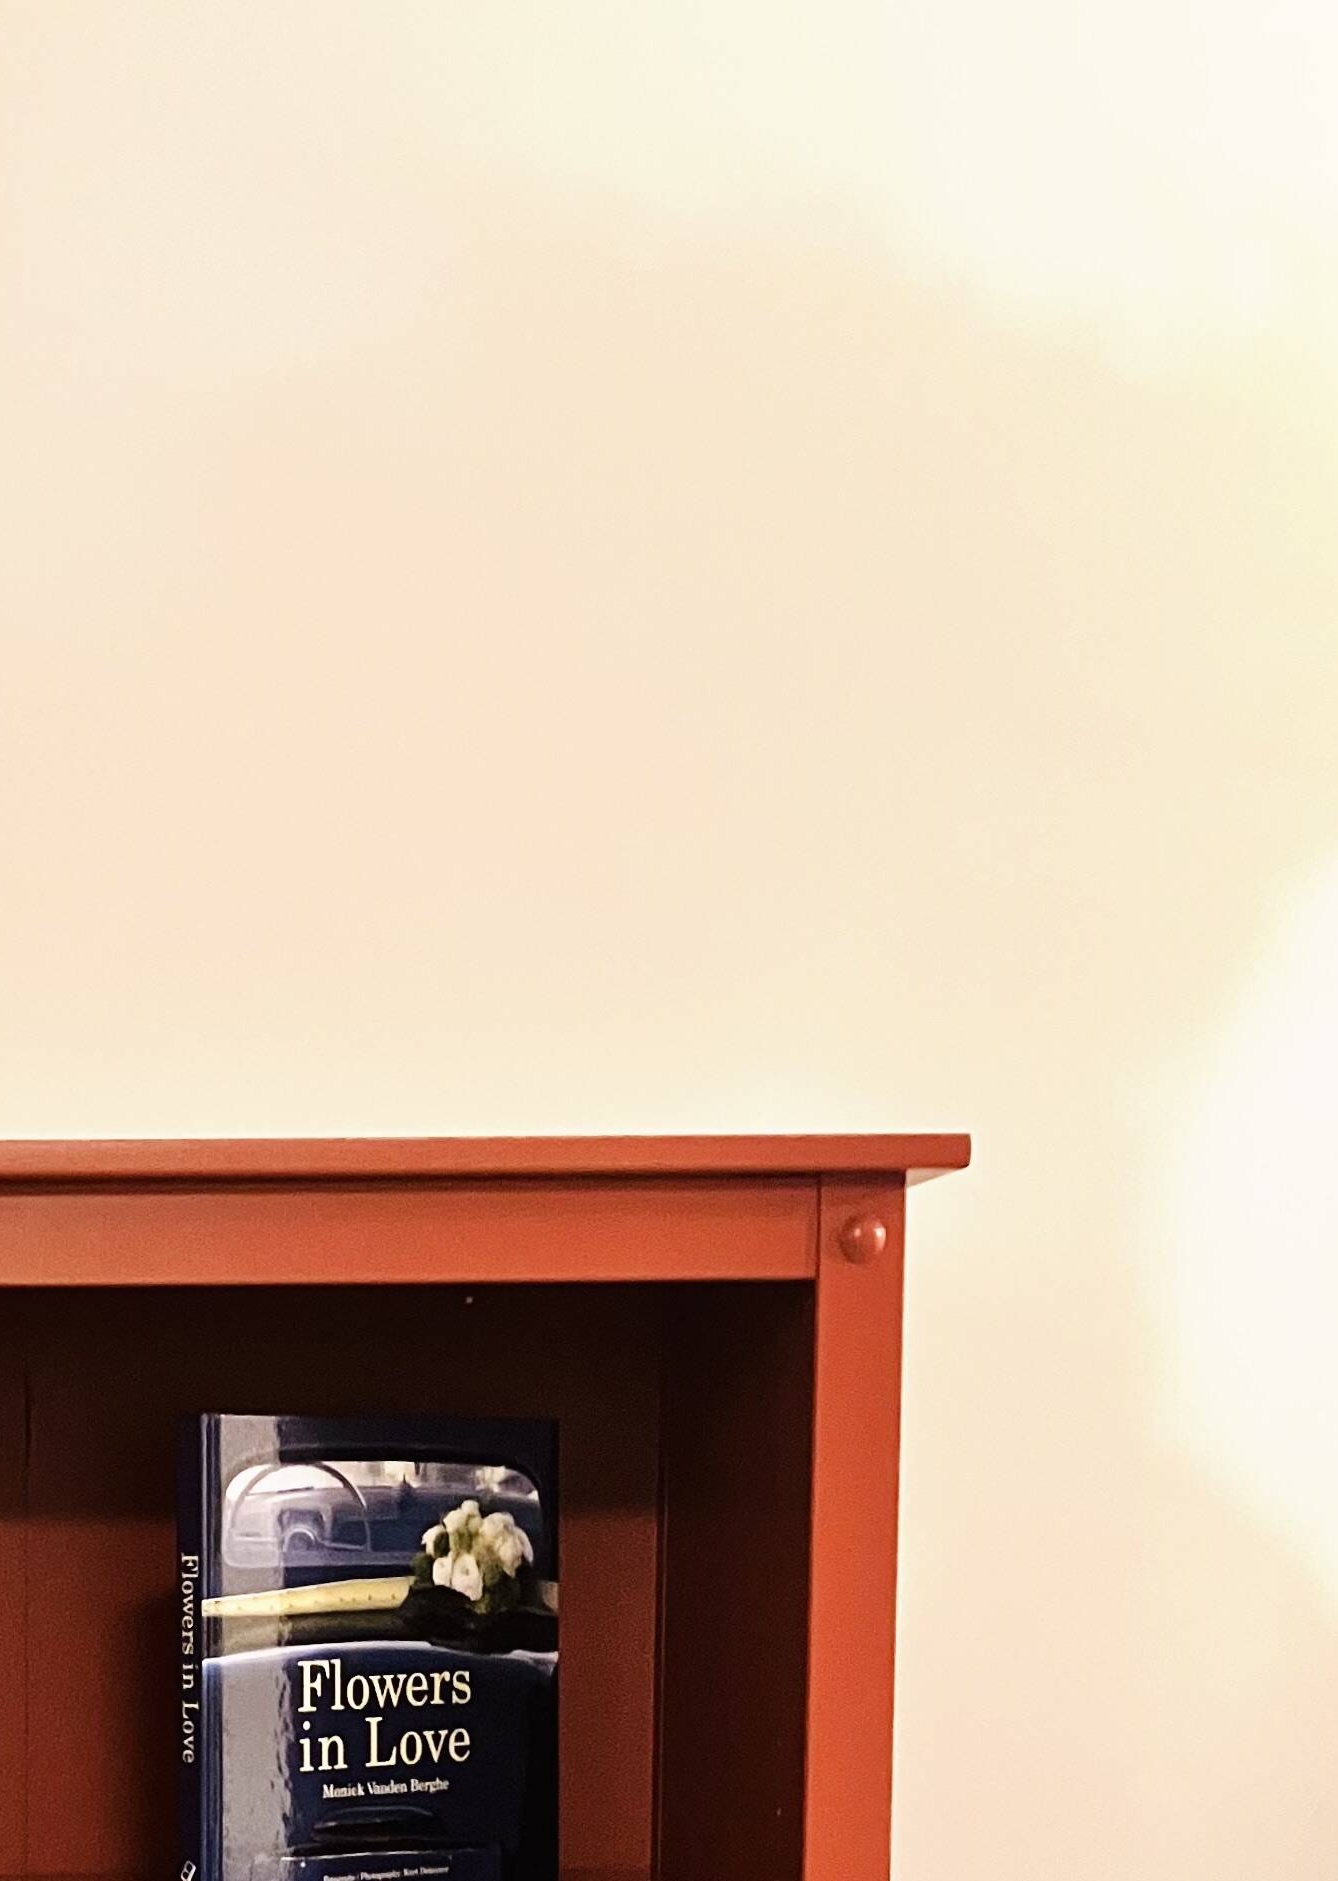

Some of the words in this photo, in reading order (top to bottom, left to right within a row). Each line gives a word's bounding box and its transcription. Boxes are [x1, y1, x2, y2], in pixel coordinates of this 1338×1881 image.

[181, 1552, 199, 1655] Flowers
[182, 1664, 198, 1690] in
[297, 1658, 471, 1713] Flowers
[182, 1701, 199, 1764] Love
[299, 1720, 348, 1772] in
[365, 1716, 471, 1767] Love
[367, 1779, 407, 1795] Vanden
[410, 1777, 450, 1794] Berghe
